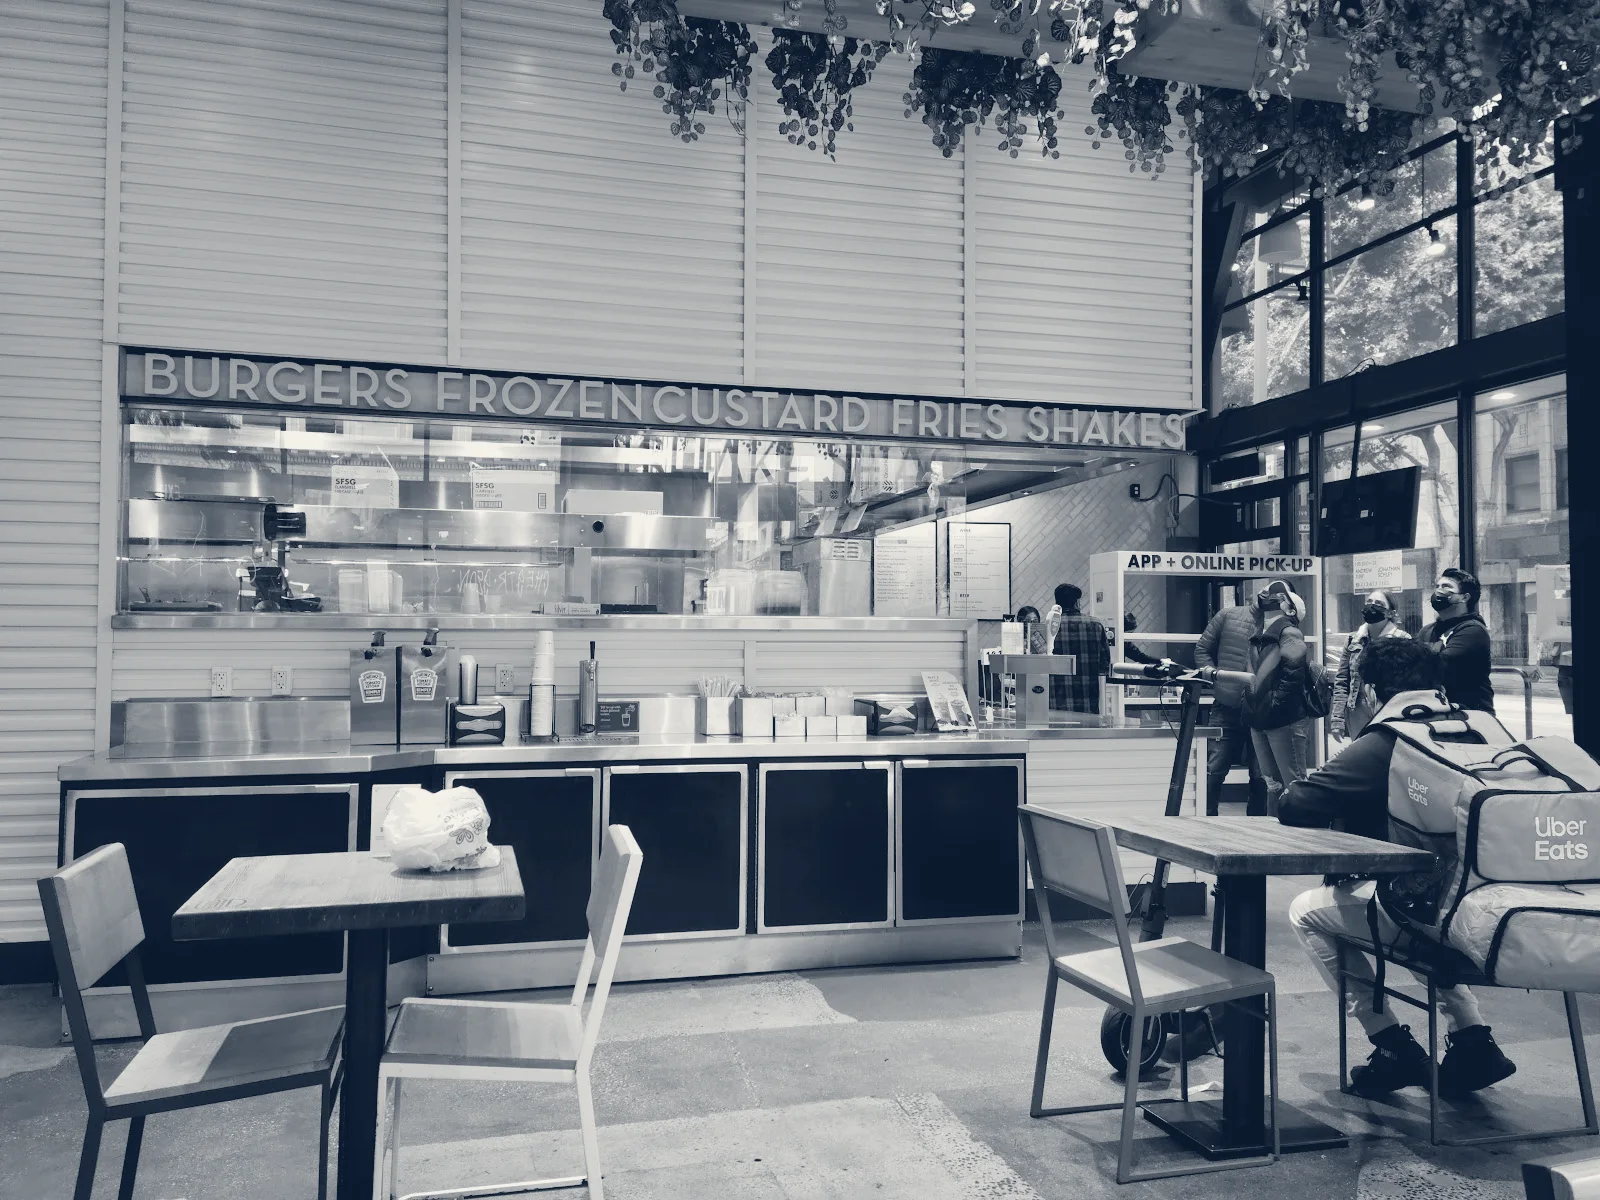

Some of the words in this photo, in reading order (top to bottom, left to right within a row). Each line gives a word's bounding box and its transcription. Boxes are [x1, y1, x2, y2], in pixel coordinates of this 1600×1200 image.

[144, 352, 412, 409] BURGERS
[436, 371, 642, 421] FROZEN
[652, 385, 871, 432] CUSTARD
[892, 399, 1008, 439] FRIES
[1027, 406, 1185, 448] SHAKES
[1127, 554, 1162, 569] APP
[1181, 555, 1245, 570] ONLINE
[1249, 557, 1313, 572] PICK-UP
[1407, 776, 1429, 794] Uber
[1407, 788, 1428, 806] Eats
[1534, 816, 1588, 838] Uber
[1534, 840, 1589, 861] Eats
